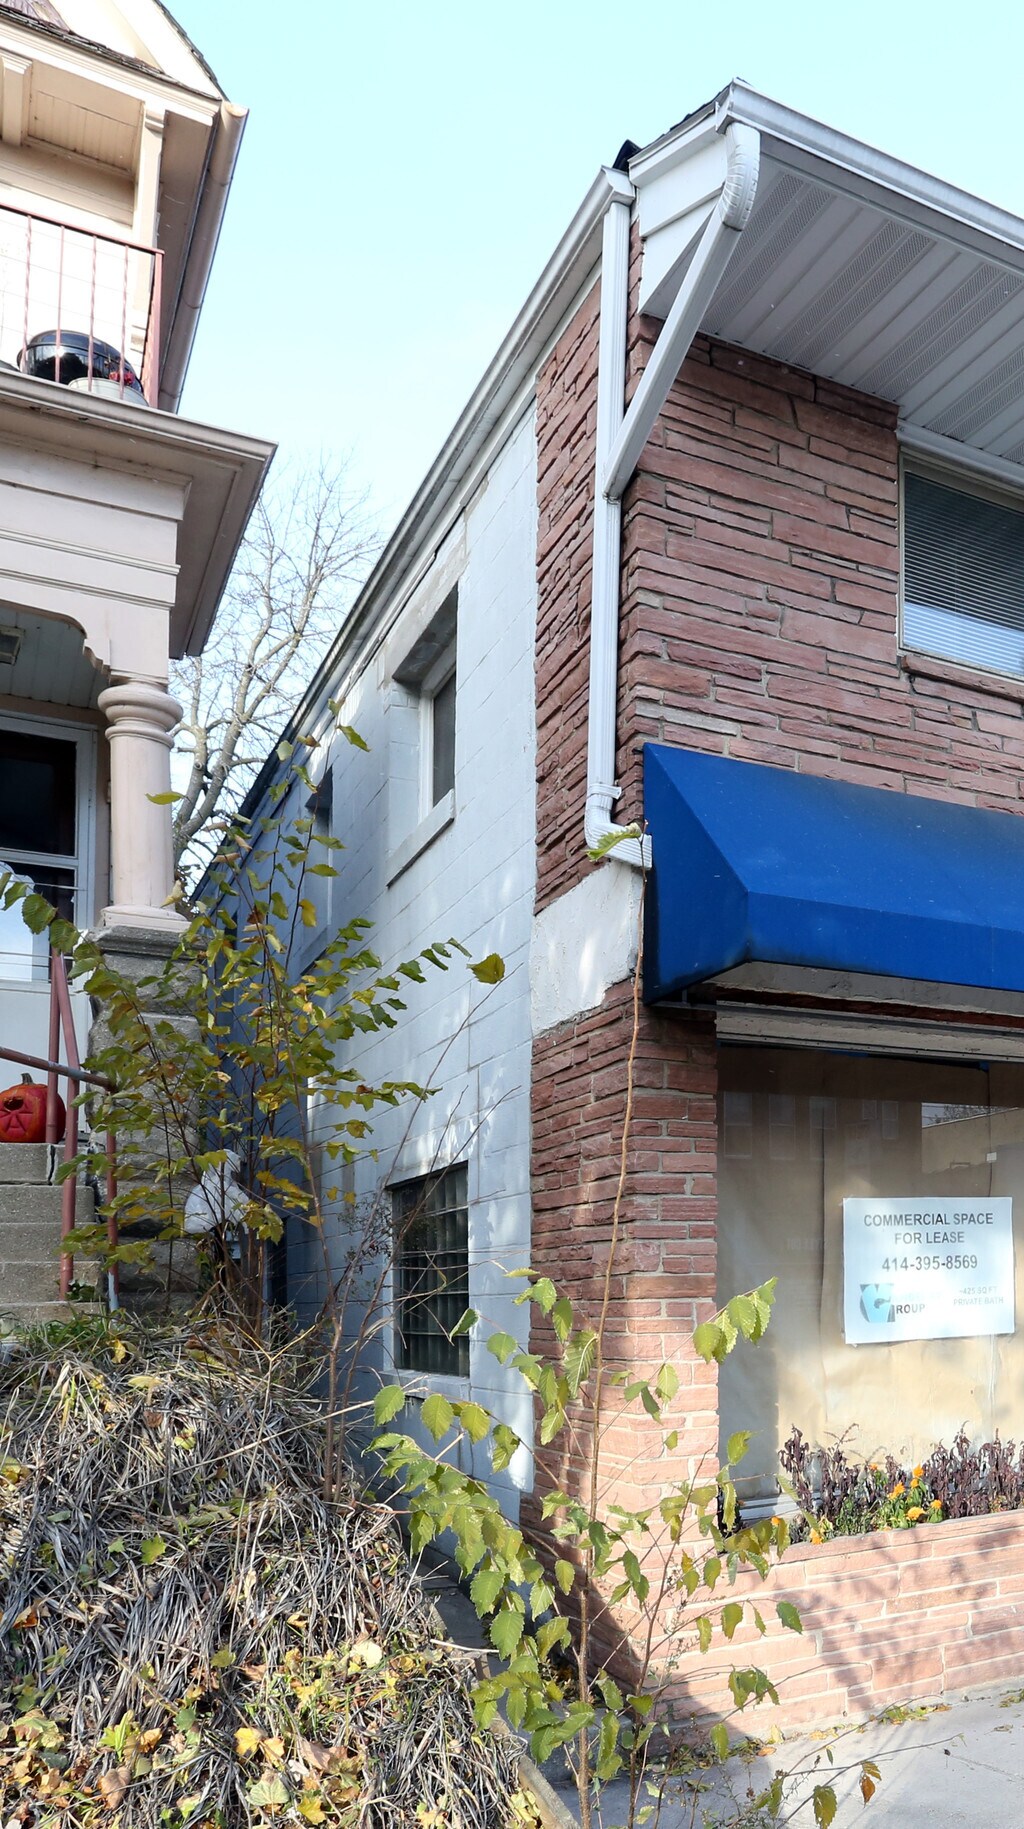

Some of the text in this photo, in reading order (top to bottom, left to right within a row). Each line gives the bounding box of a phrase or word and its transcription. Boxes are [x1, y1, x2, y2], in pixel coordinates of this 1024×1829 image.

[864, 1213, 994, 1227] COMMERCIAL SPACE
[894, 1231, 965, 1245] FOR LEASE
[882, 1255, 978, 1272] 414-395-8569
[977, 1286, 987, 1294] SQ
[953, 1297, 982, 1306] PRIVATE
[984, 1297, 1004, 1305] BATH
